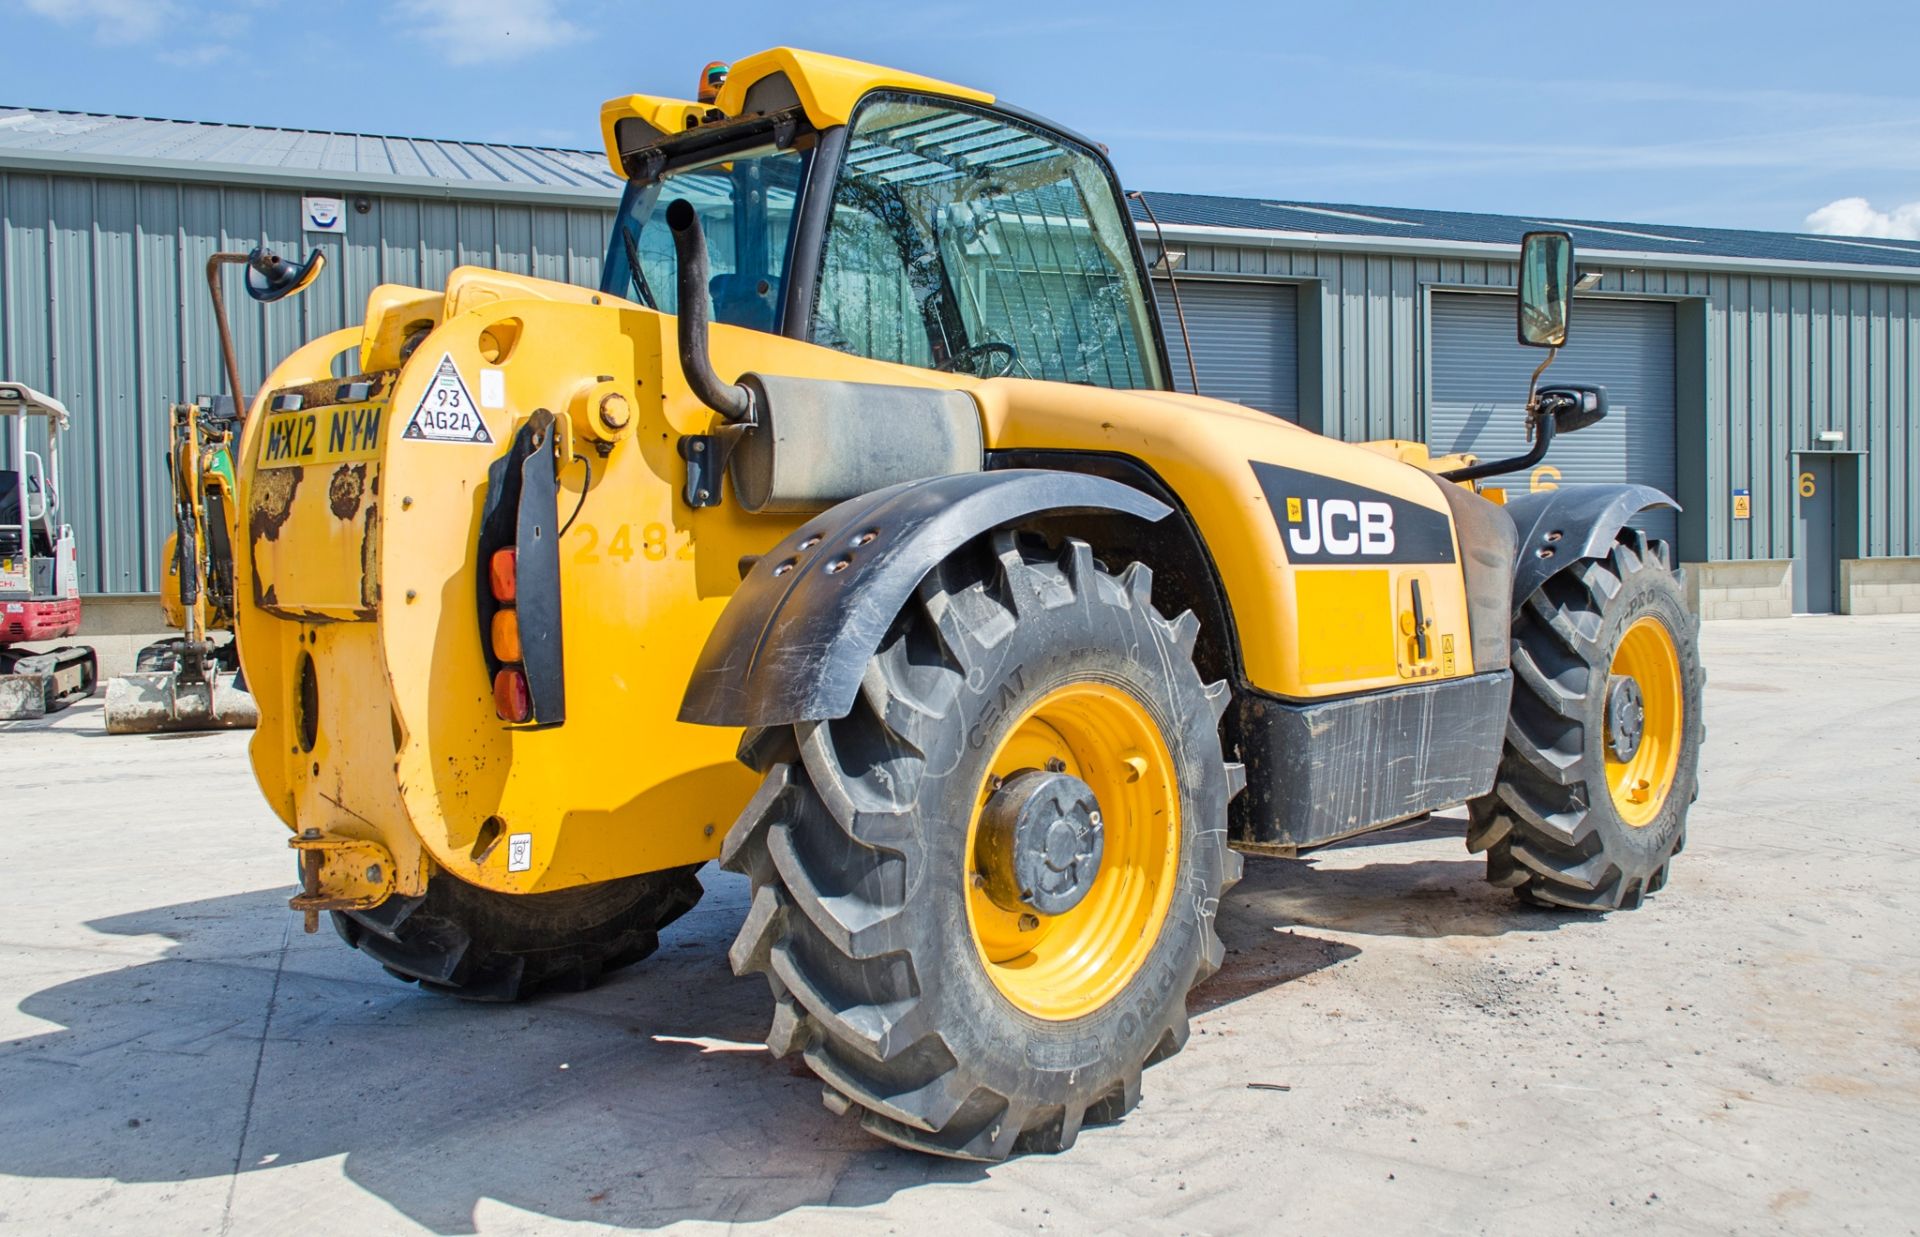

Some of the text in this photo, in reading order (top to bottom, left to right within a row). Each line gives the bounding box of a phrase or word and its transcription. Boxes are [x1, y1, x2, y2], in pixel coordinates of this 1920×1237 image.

[437, 389, 460, 408] 93
[265, 407, 382, 461] MX12 NYM
[424, 411, 471, 431] AG2A
[1799, 472, 1816, 498] 6
[1288, 498, 1395, 555] JCB
[967, 663, 1024, 750] CEAT
